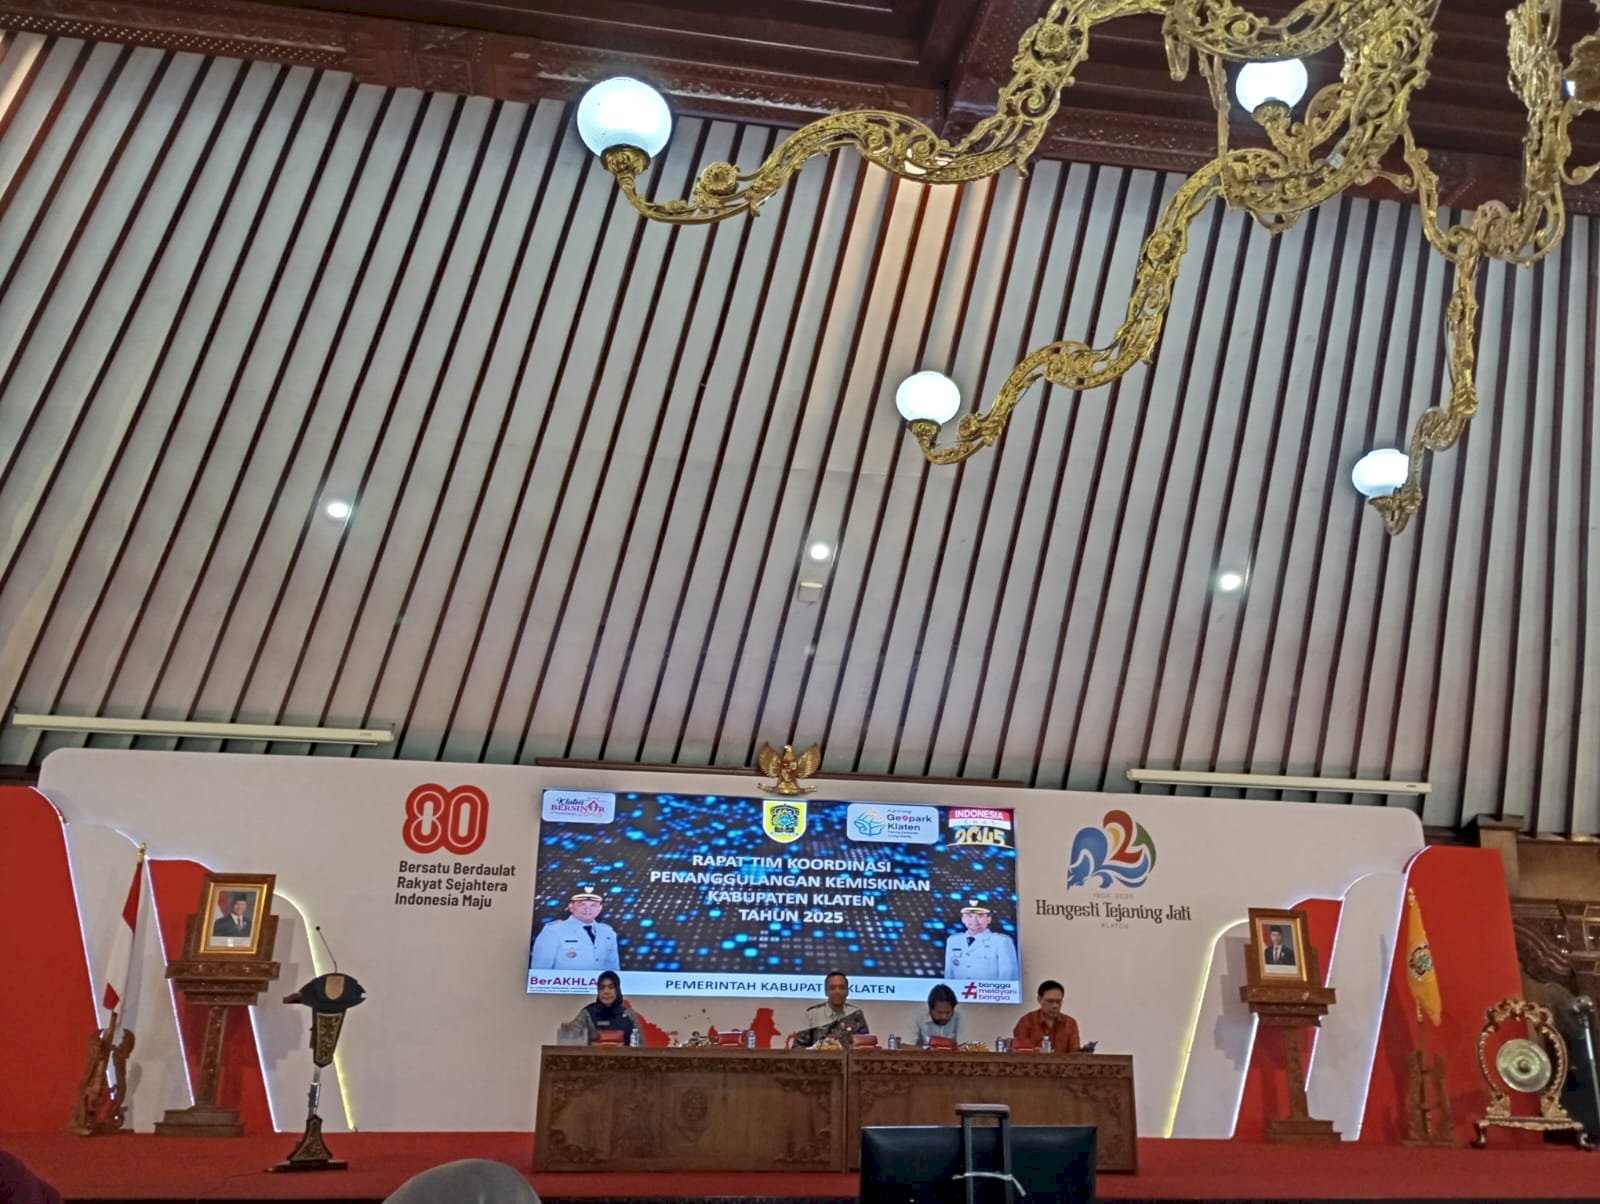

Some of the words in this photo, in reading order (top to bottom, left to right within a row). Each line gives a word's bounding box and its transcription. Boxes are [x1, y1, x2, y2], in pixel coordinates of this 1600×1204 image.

[954, 809, 1004, 819] INDONESIA
[887, 822, 921, 831] Klaten
[399, 860, 450, 874] Bersatu
[453, 862, 516, 877] Berdaulat
[692, 853, 746, 868] RAPAT
[751, 856, 783, 869] TIM
[786, 857, 892, 873] KOORDINASI
[397, 876, 442, 892] Rakyat
[445, 878, 508, 894] Sejahtera
[650, 869, 820, 888] PENANGGULANGAN
[825, 874, 930, 892] KEMISKINAN
[395, 893, 459, 907] Indonesia
[462, 894, 492, 910] Maju
[707, 890, 808, 906] KABUPATEN
[812, 892, 875, 907] KLATEN
[739, 908, 798, 923] TAHUN
[802, 909, 844, 924] 2025
[1035, 899, 1099, 920] Hangesti
[1102, 902, 1163, 924] Tejaning
[1166, 905, 1192, 921] Jati
[529, 976, 598, 986] BerAKHLA
[665, 980, 756, 991] PEMERINTAH
[760, 981, 823, 993] KABUPAT
